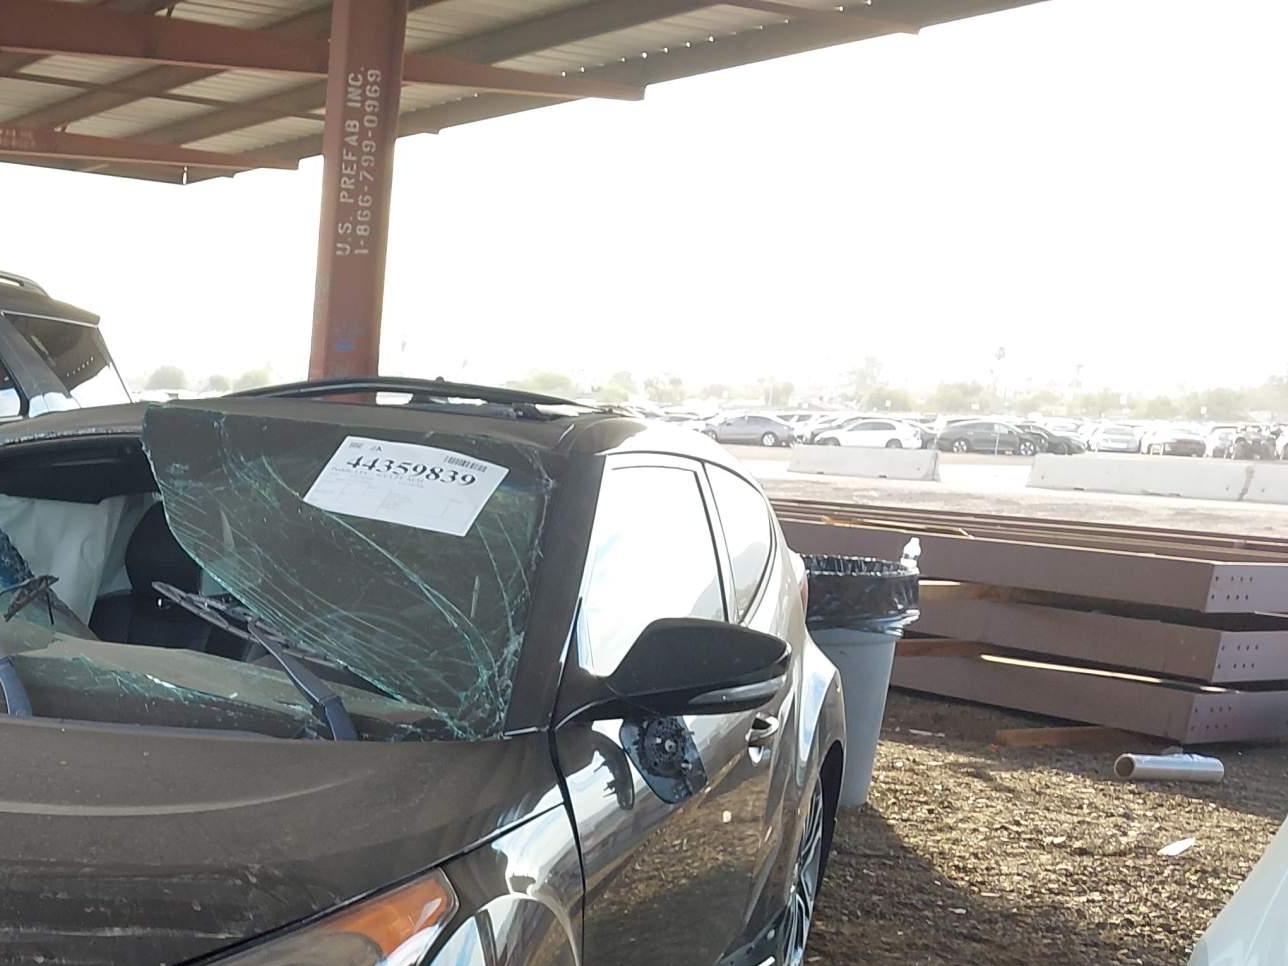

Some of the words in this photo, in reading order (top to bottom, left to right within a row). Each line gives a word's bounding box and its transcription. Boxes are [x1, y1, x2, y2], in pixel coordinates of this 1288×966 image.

[347, 67, 365, 108] INC.
[339, 119, 360, 203] PREFAB
[354, 69, 382, 255] 1-866-799-0969
[336, 216, 353, 256] U.S.
[346, 455, 477, 487] 44359839
